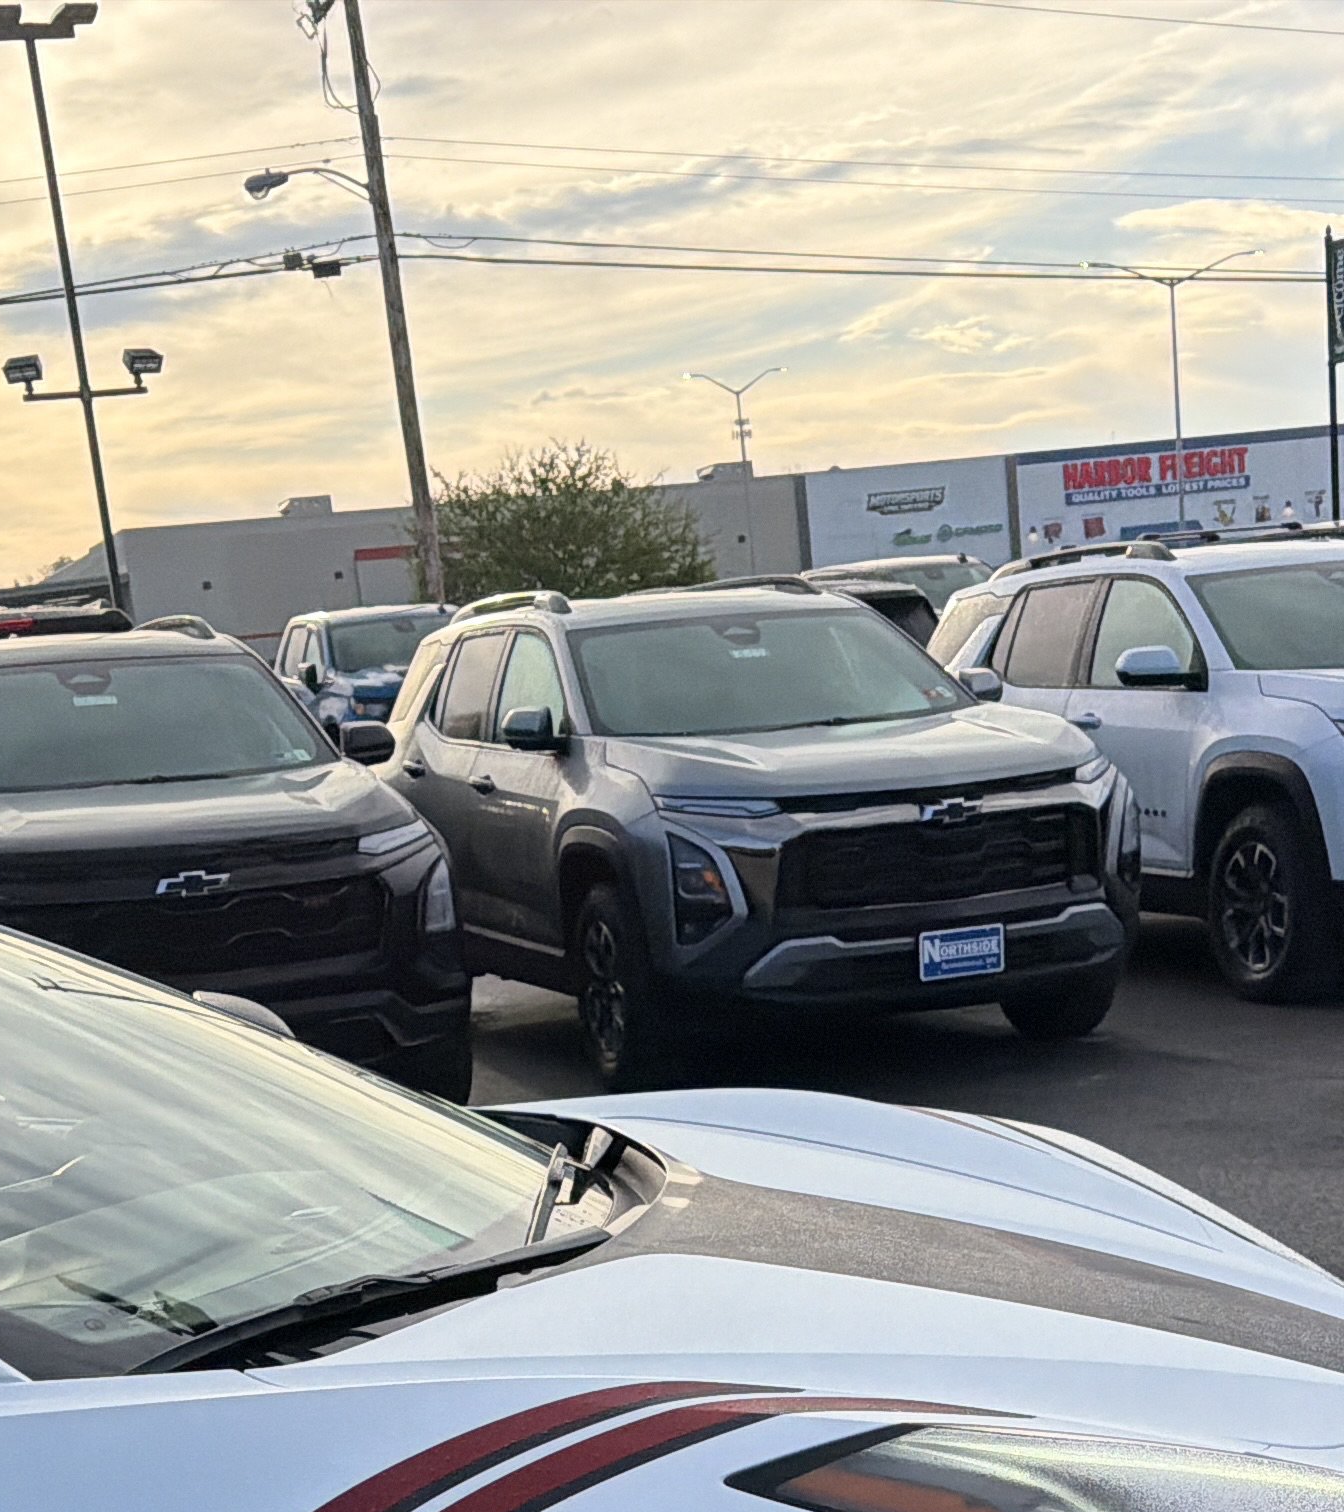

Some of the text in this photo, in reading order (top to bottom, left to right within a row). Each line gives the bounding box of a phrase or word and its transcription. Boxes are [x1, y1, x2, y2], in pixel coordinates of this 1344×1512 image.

[1063, 457, 1152, 491] HARBOR
[1071, 490, 1118, 503] QUALITY
[1120, 486, 1156, 498] TOOLS
[1207, 477, 1246, 489] PRICES
[923, 937, 1000, 964] NORTHSIDE
